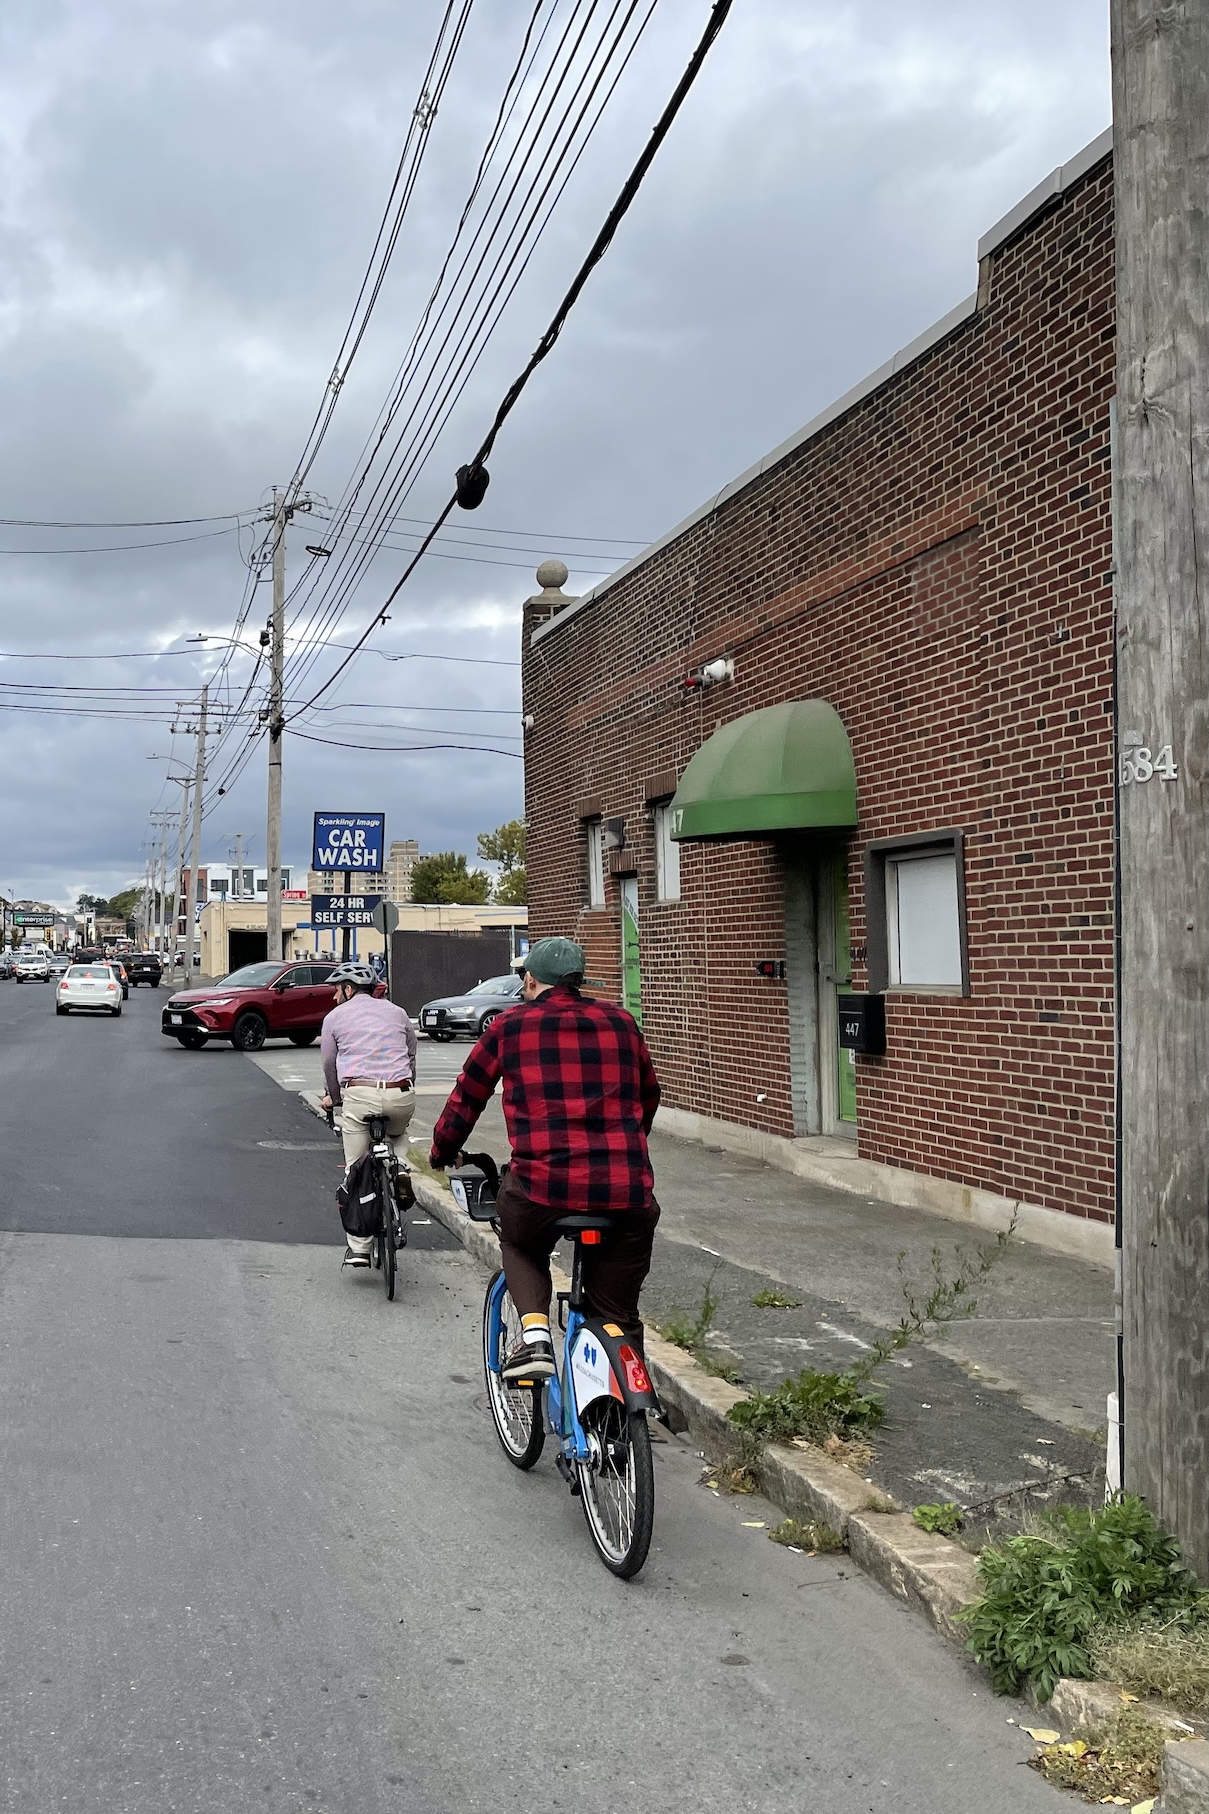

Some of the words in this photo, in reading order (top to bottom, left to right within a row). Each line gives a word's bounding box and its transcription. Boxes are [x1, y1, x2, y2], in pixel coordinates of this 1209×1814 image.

[318, 818, 355, 827] Sparkling
[356, 819, 380, 827] Image
[328, 829, 366, 847] CAR
[318, 848, 377, 866] WASH
[329, 897, 345, 909] 24
[347, 897, 365, 909] HR
[15, 915, 53, 924] enterprise
[315, 912, 344, 923] SELF
[845, 1023, 859, 1037] 447
